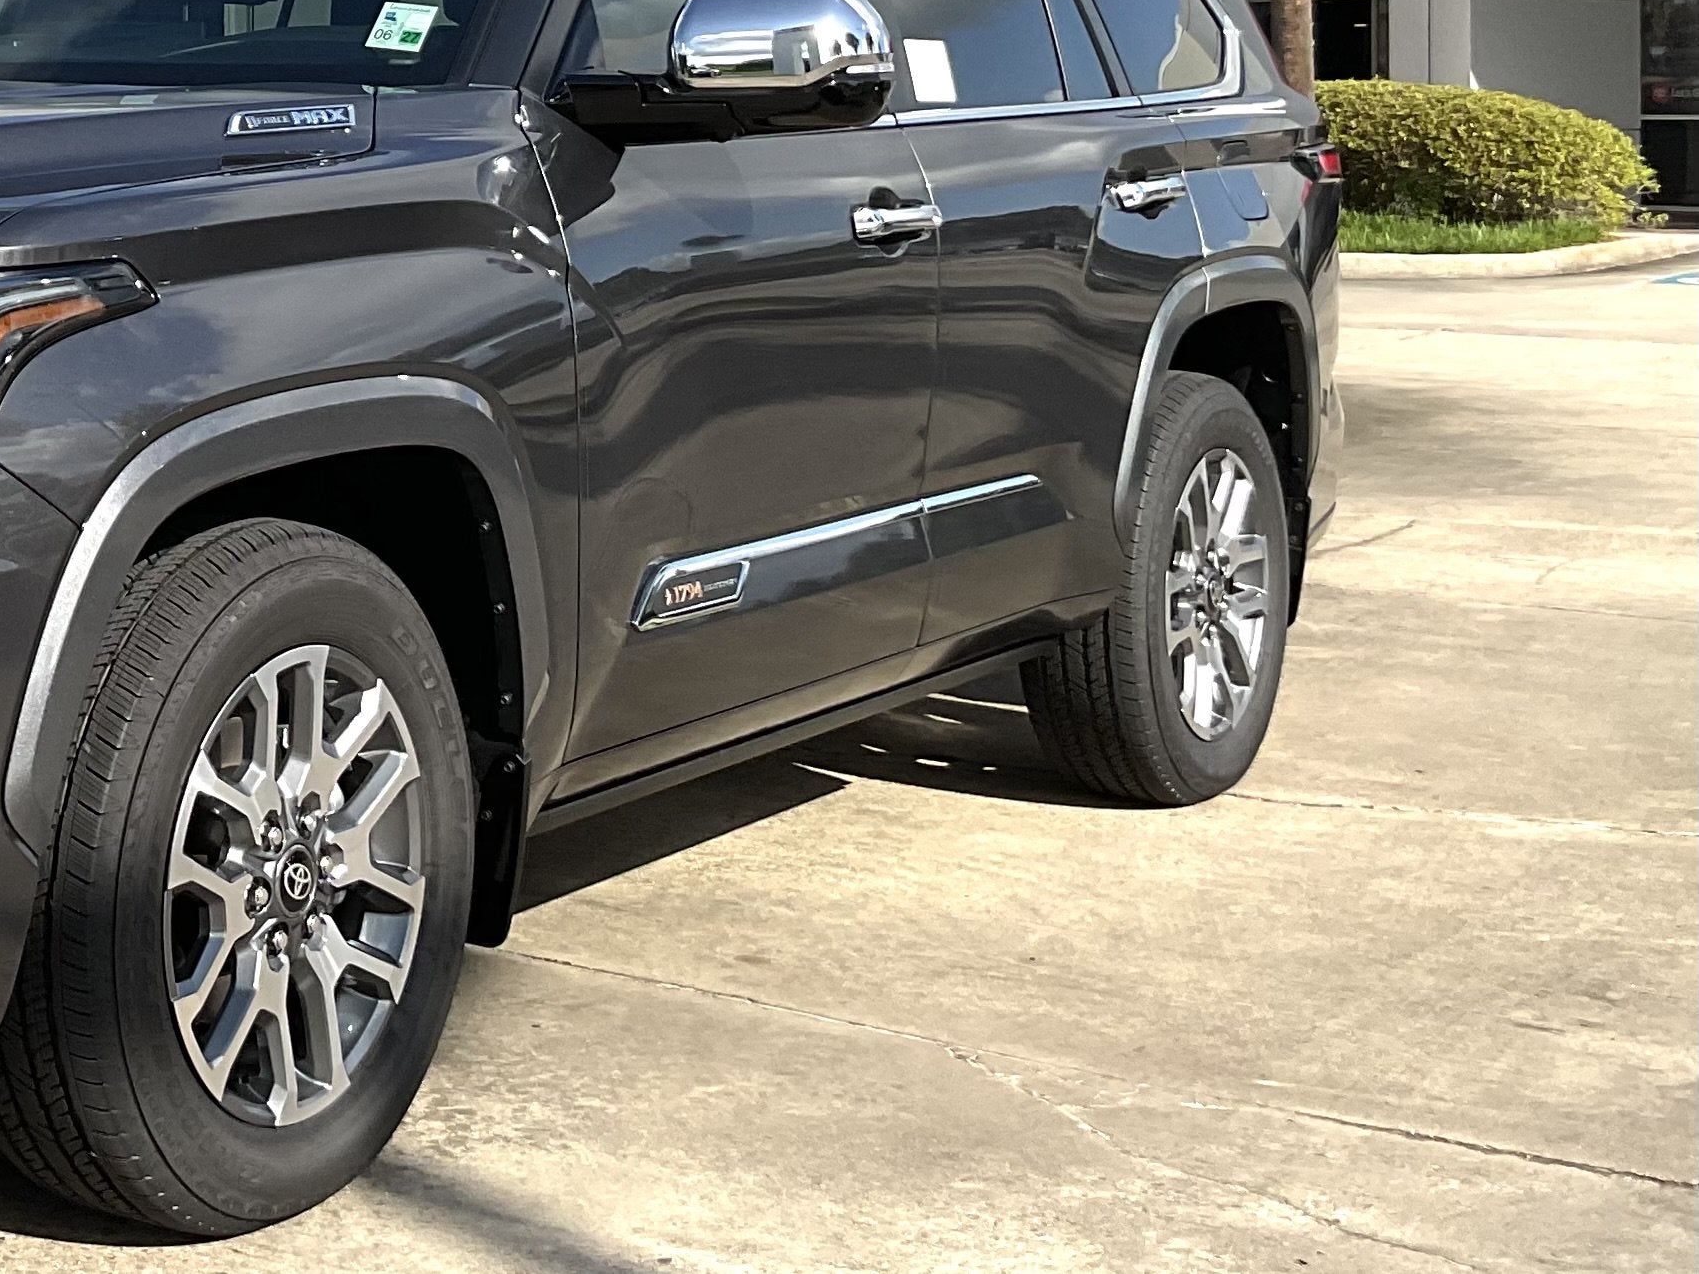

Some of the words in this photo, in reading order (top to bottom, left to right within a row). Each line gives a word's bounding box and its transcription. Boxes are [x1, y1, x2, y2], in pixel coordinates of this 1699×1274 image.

[374, 28, 393, 41] 06
[401, 31, 422, 43] 27
[290, 108, 348, 125] MAX
[673, 581, 703, 604] 1794
